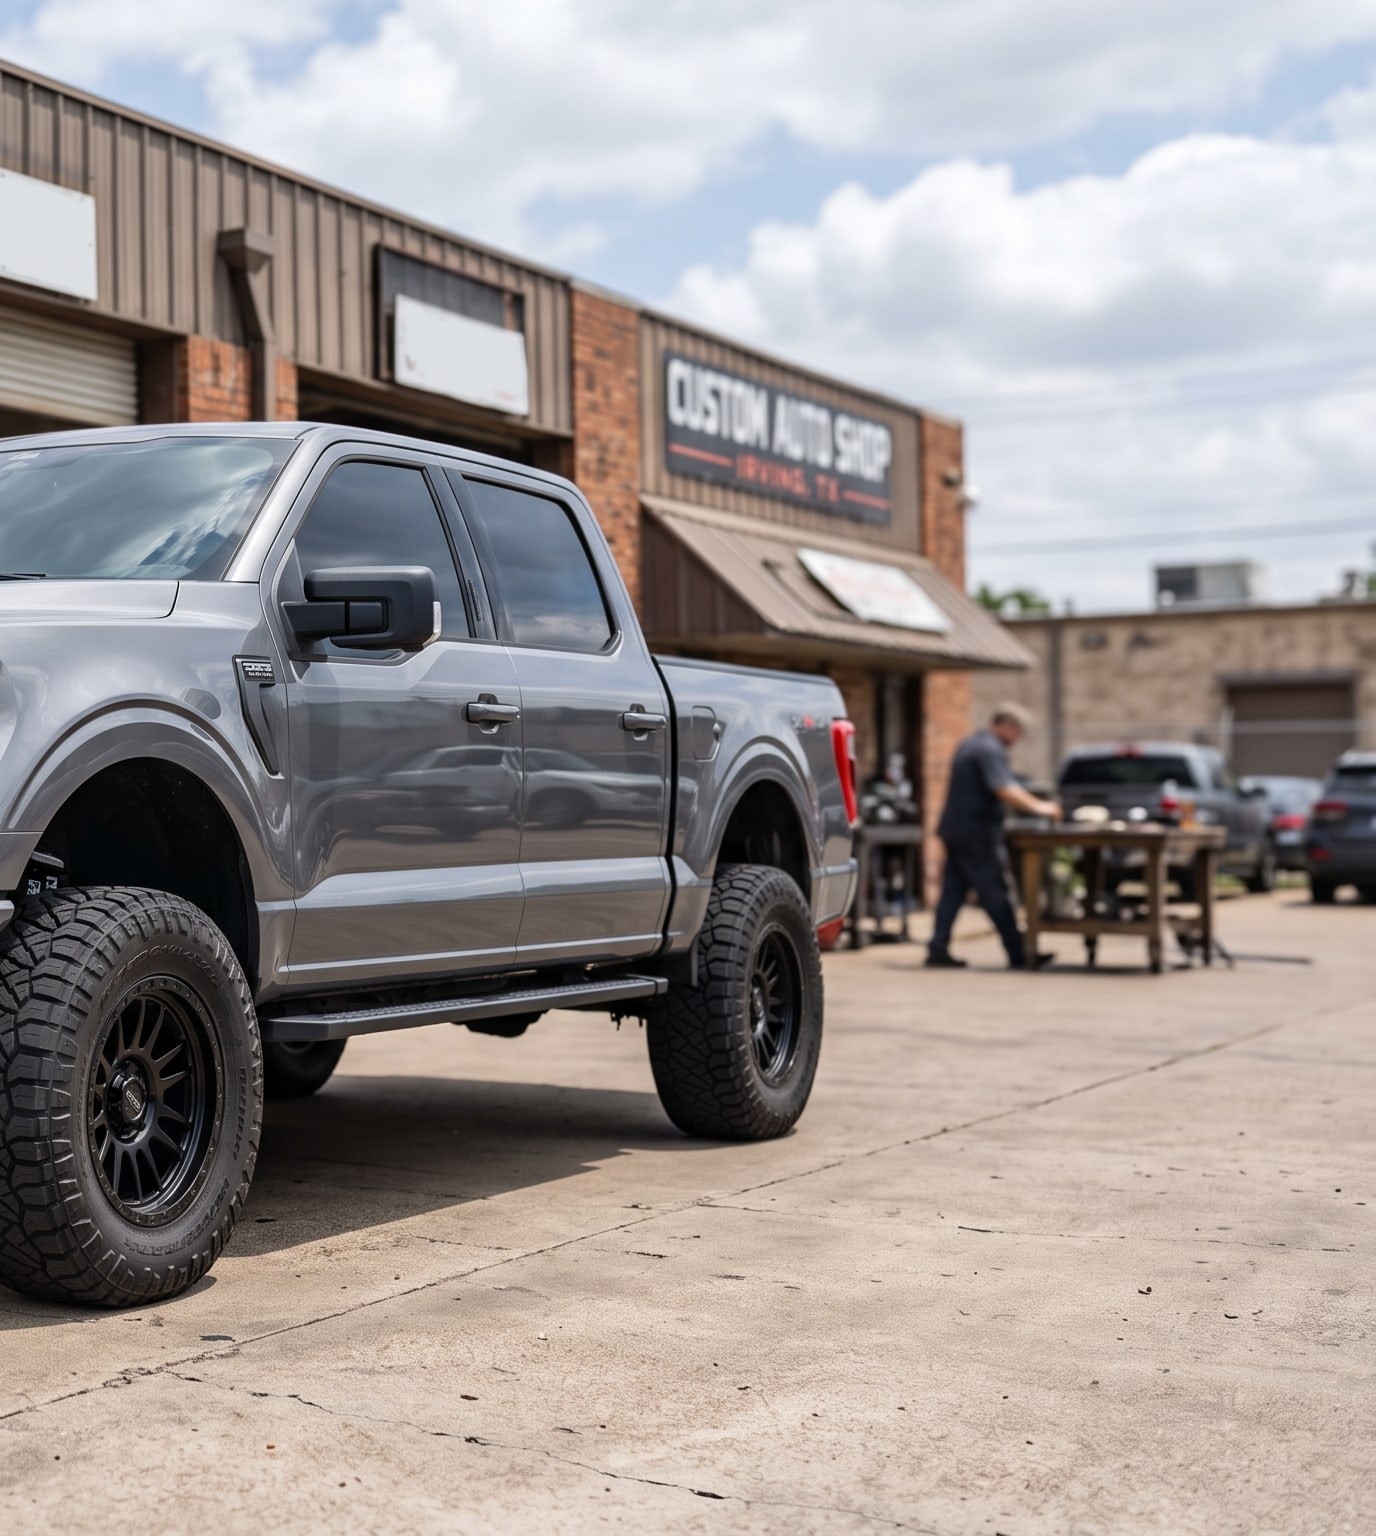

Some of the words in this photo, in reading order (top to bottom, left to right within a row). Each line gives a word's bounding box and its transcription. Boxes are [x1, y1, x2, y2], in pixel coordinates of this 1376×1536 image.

[667, 358, 769, 450] CUSTOM
[773, 395, 833, 468] AUTO
[834, 413, 892, 483] SHOP
[815, 474, 839, 503] TX
